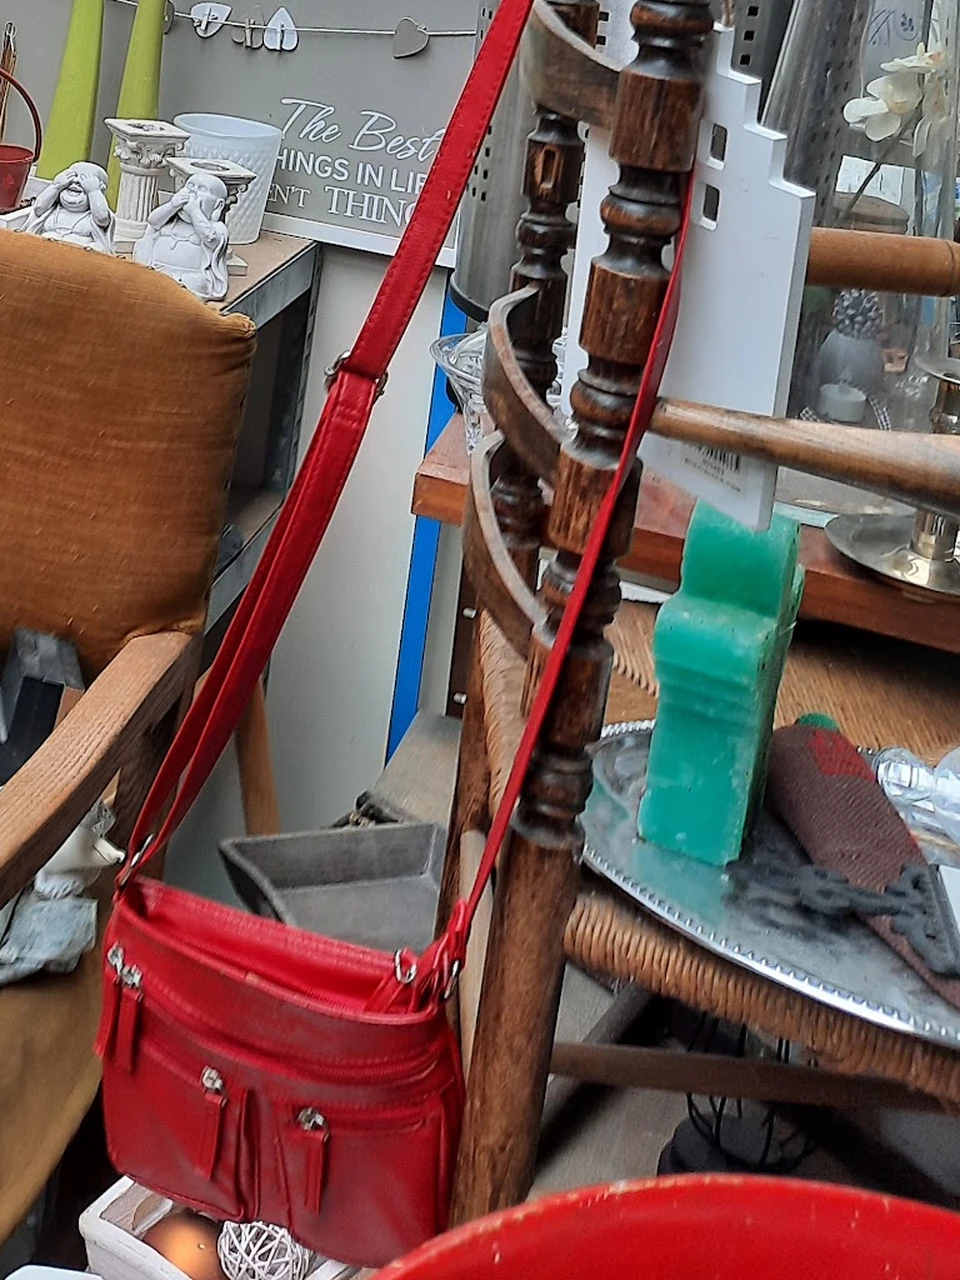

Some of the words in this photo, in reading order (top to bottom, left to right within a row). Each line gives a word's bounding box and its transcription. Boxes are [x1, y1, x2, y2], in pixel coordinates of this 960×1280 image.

[281, 98, 342, 143] The
[348, 110, 446, 162] Best
[276, 148, 350, 181] HINGS
[356, 162, 384, 188] IN
[390, 169, 429, 195] LIF
